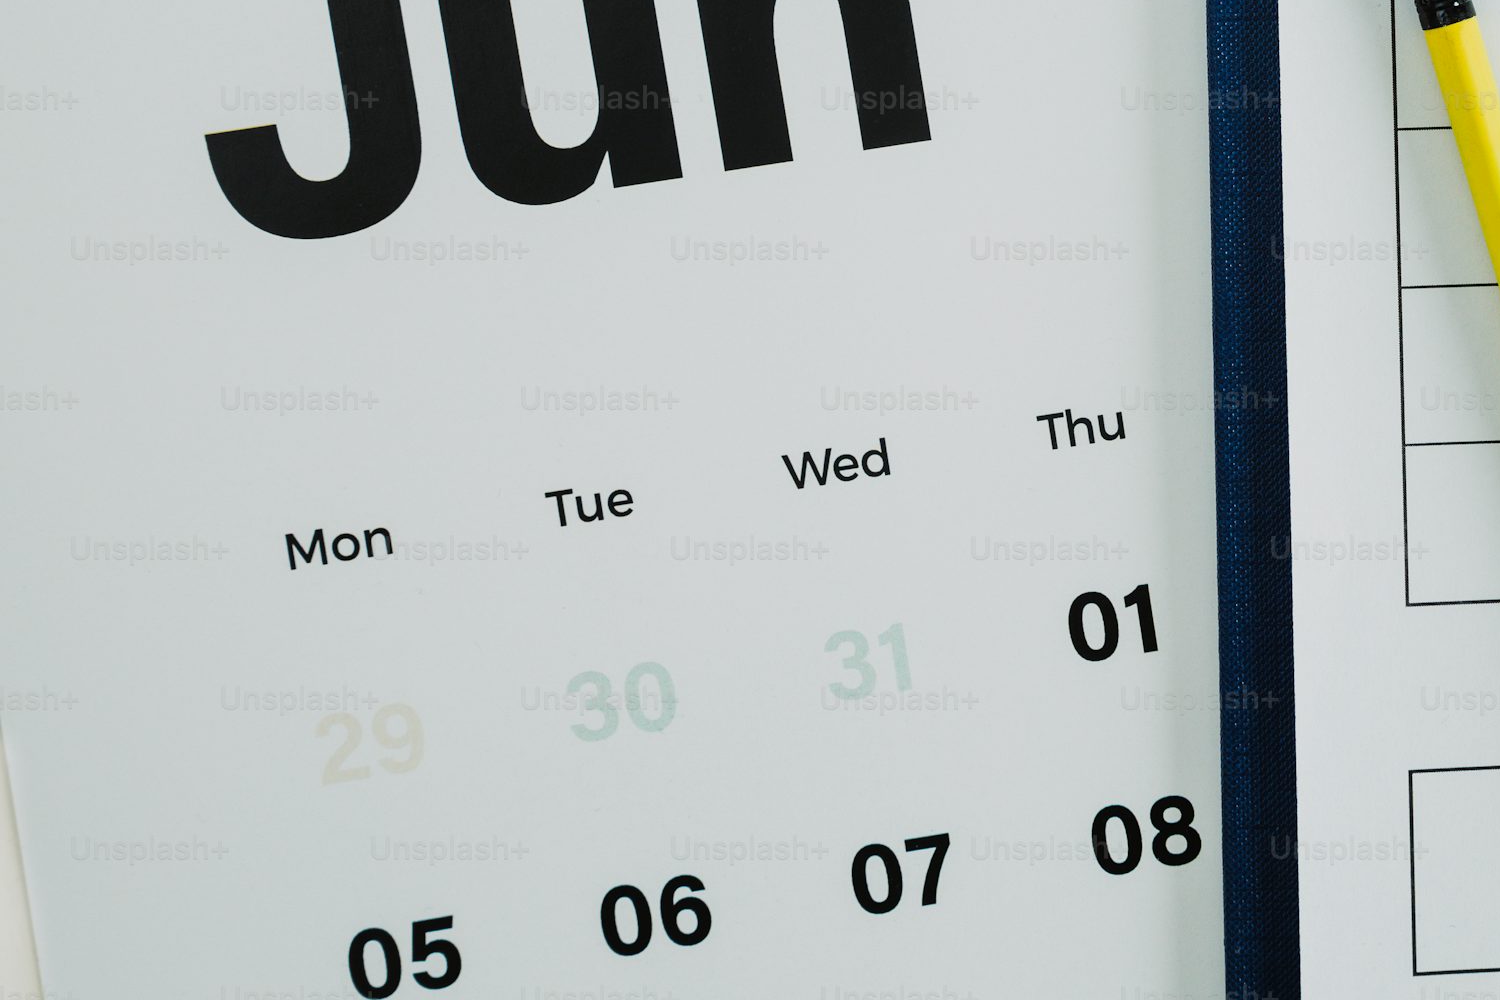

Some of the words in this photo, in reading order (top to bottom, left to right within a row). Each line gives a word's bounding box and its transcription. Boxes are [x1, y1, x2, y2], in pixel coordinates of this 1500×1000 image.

[284, 527, 394, 571] Mon
[544, 488, 634, 527] Tue
[781, 437, 891, 490] Wed
[1036, 408, 1126, 450] Thu
[315, 703, 426, 786] 29
[565, 661, 678, 742] 30
[823, 622, 914, 702] 31
[1068, 583, 1159, 662] 01
[348, 915, 462, 1000] 05
[600, 874, 712, 957] 06
[851, 832, 951, 915] 07
[1091, 795, 1202, 876] 08
